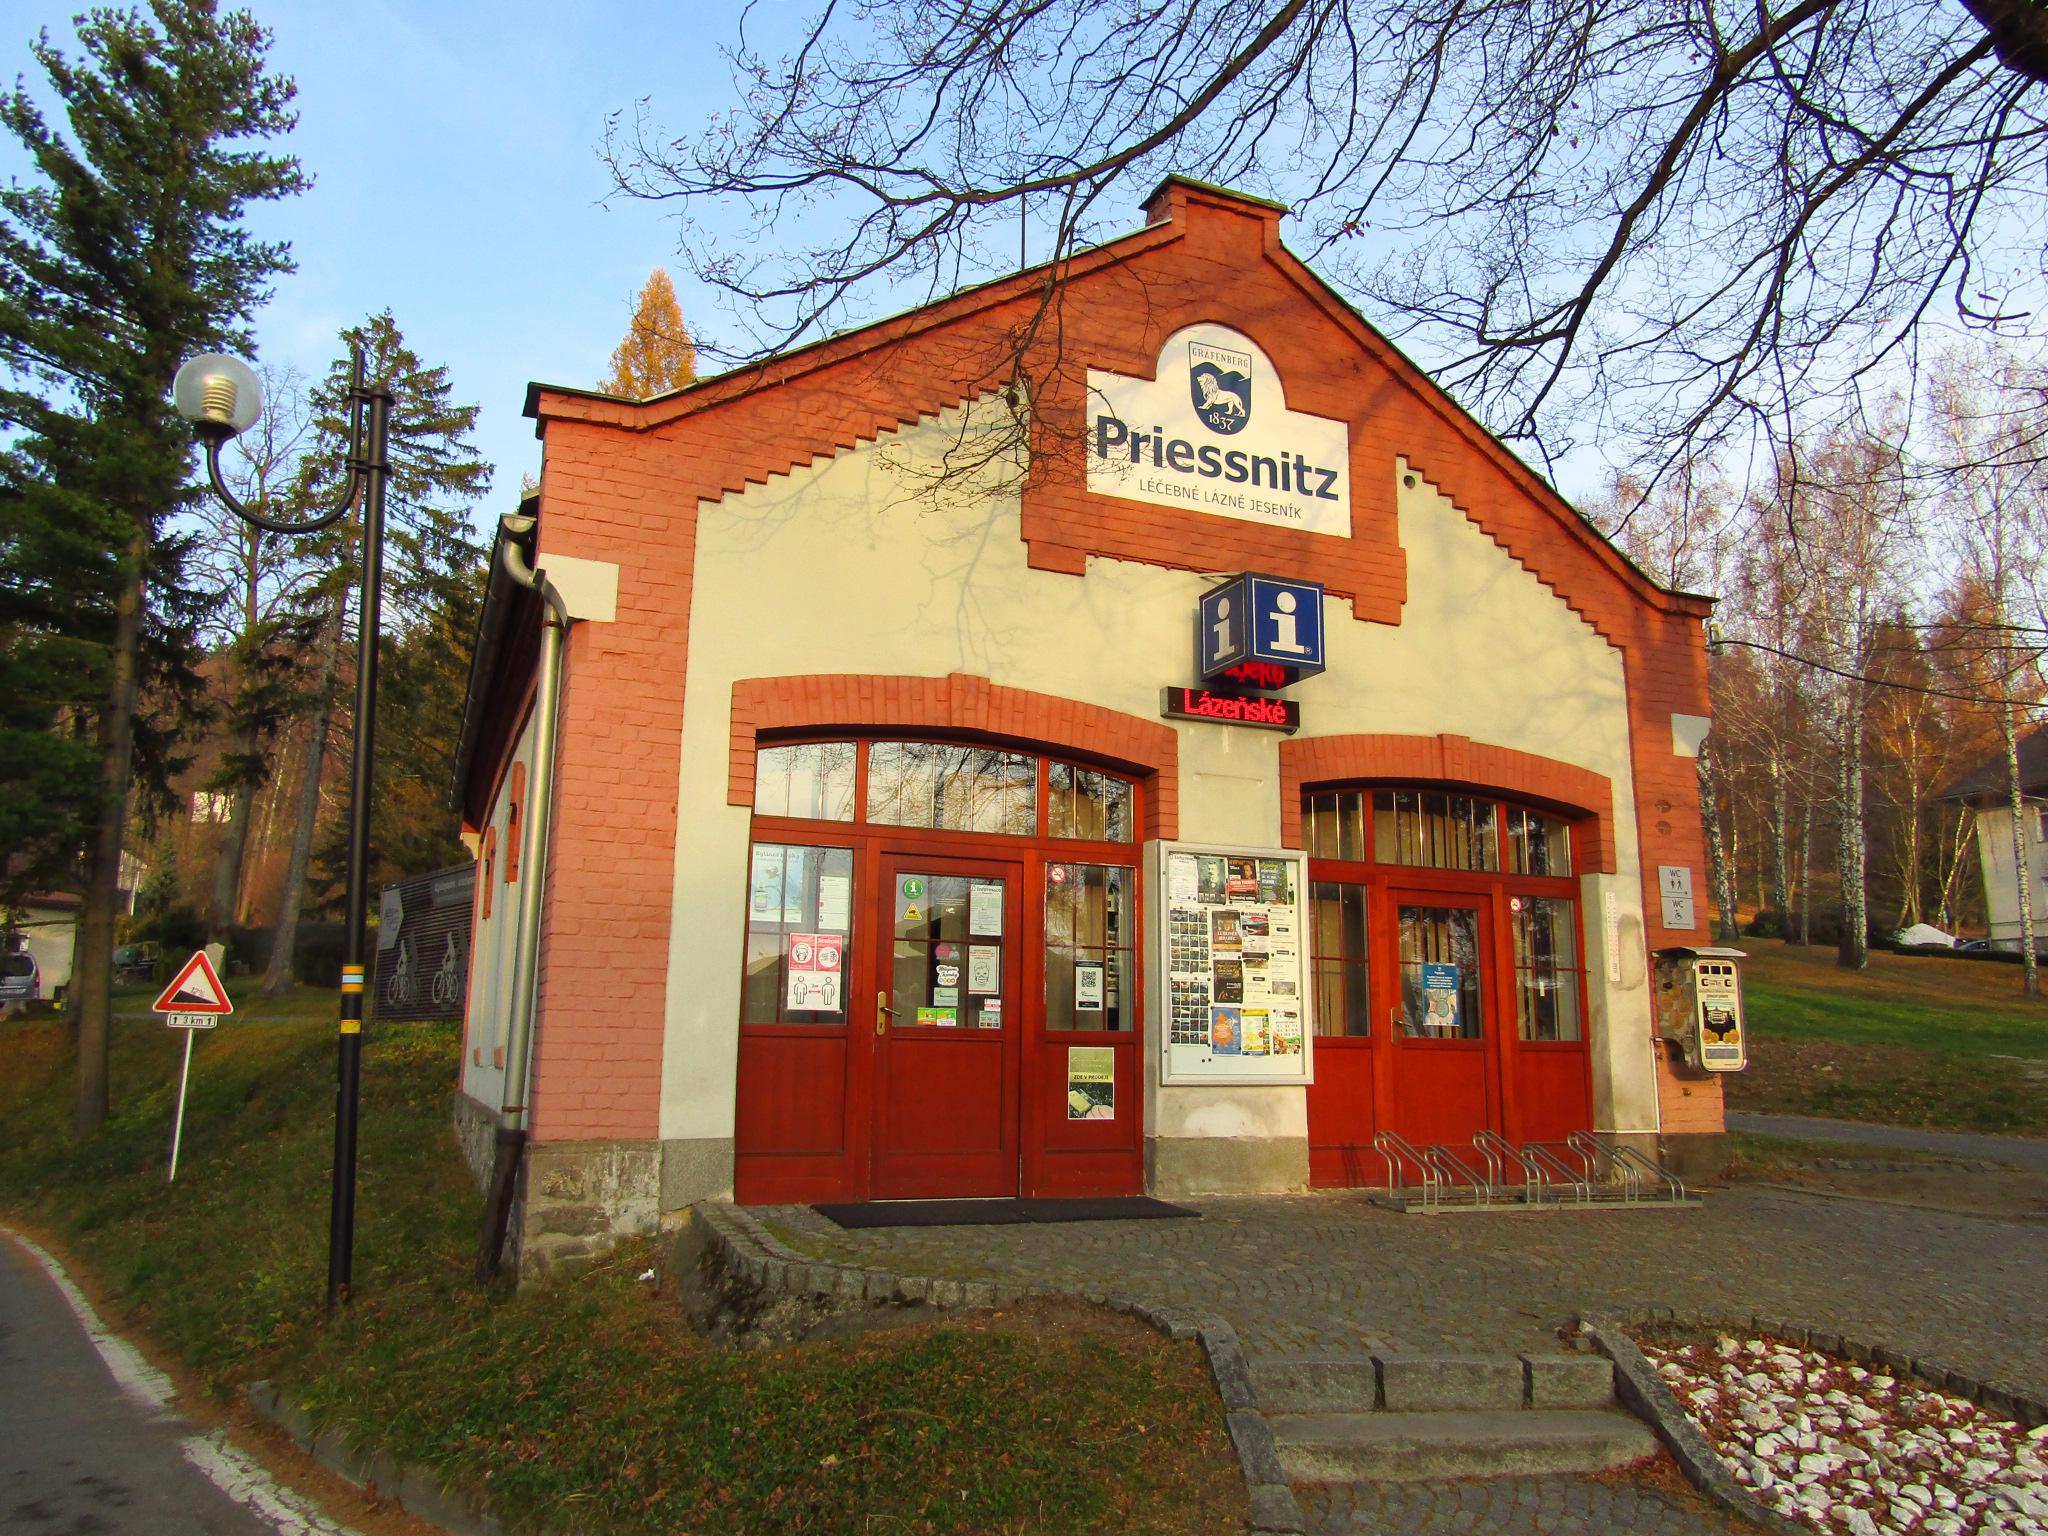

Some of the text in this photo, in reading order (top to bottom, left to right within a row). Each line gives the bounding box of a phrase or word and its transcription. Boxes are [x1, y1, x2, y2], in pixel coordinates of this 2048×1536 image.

[1208, 412, 1235, 431] 1837
[1097, 415, 1339, 501] Priessnitz
[1139, 478, 1302, 519] LÉČEBNÉ LÁZNĚ JESENÍK
[1184, 688, 1286, 724] Lázeňské
[1670, 869, 1681, 877] WC
[1672, 899, 1684, 908] WC
[183, 1016, 203, 1024] 3 km
